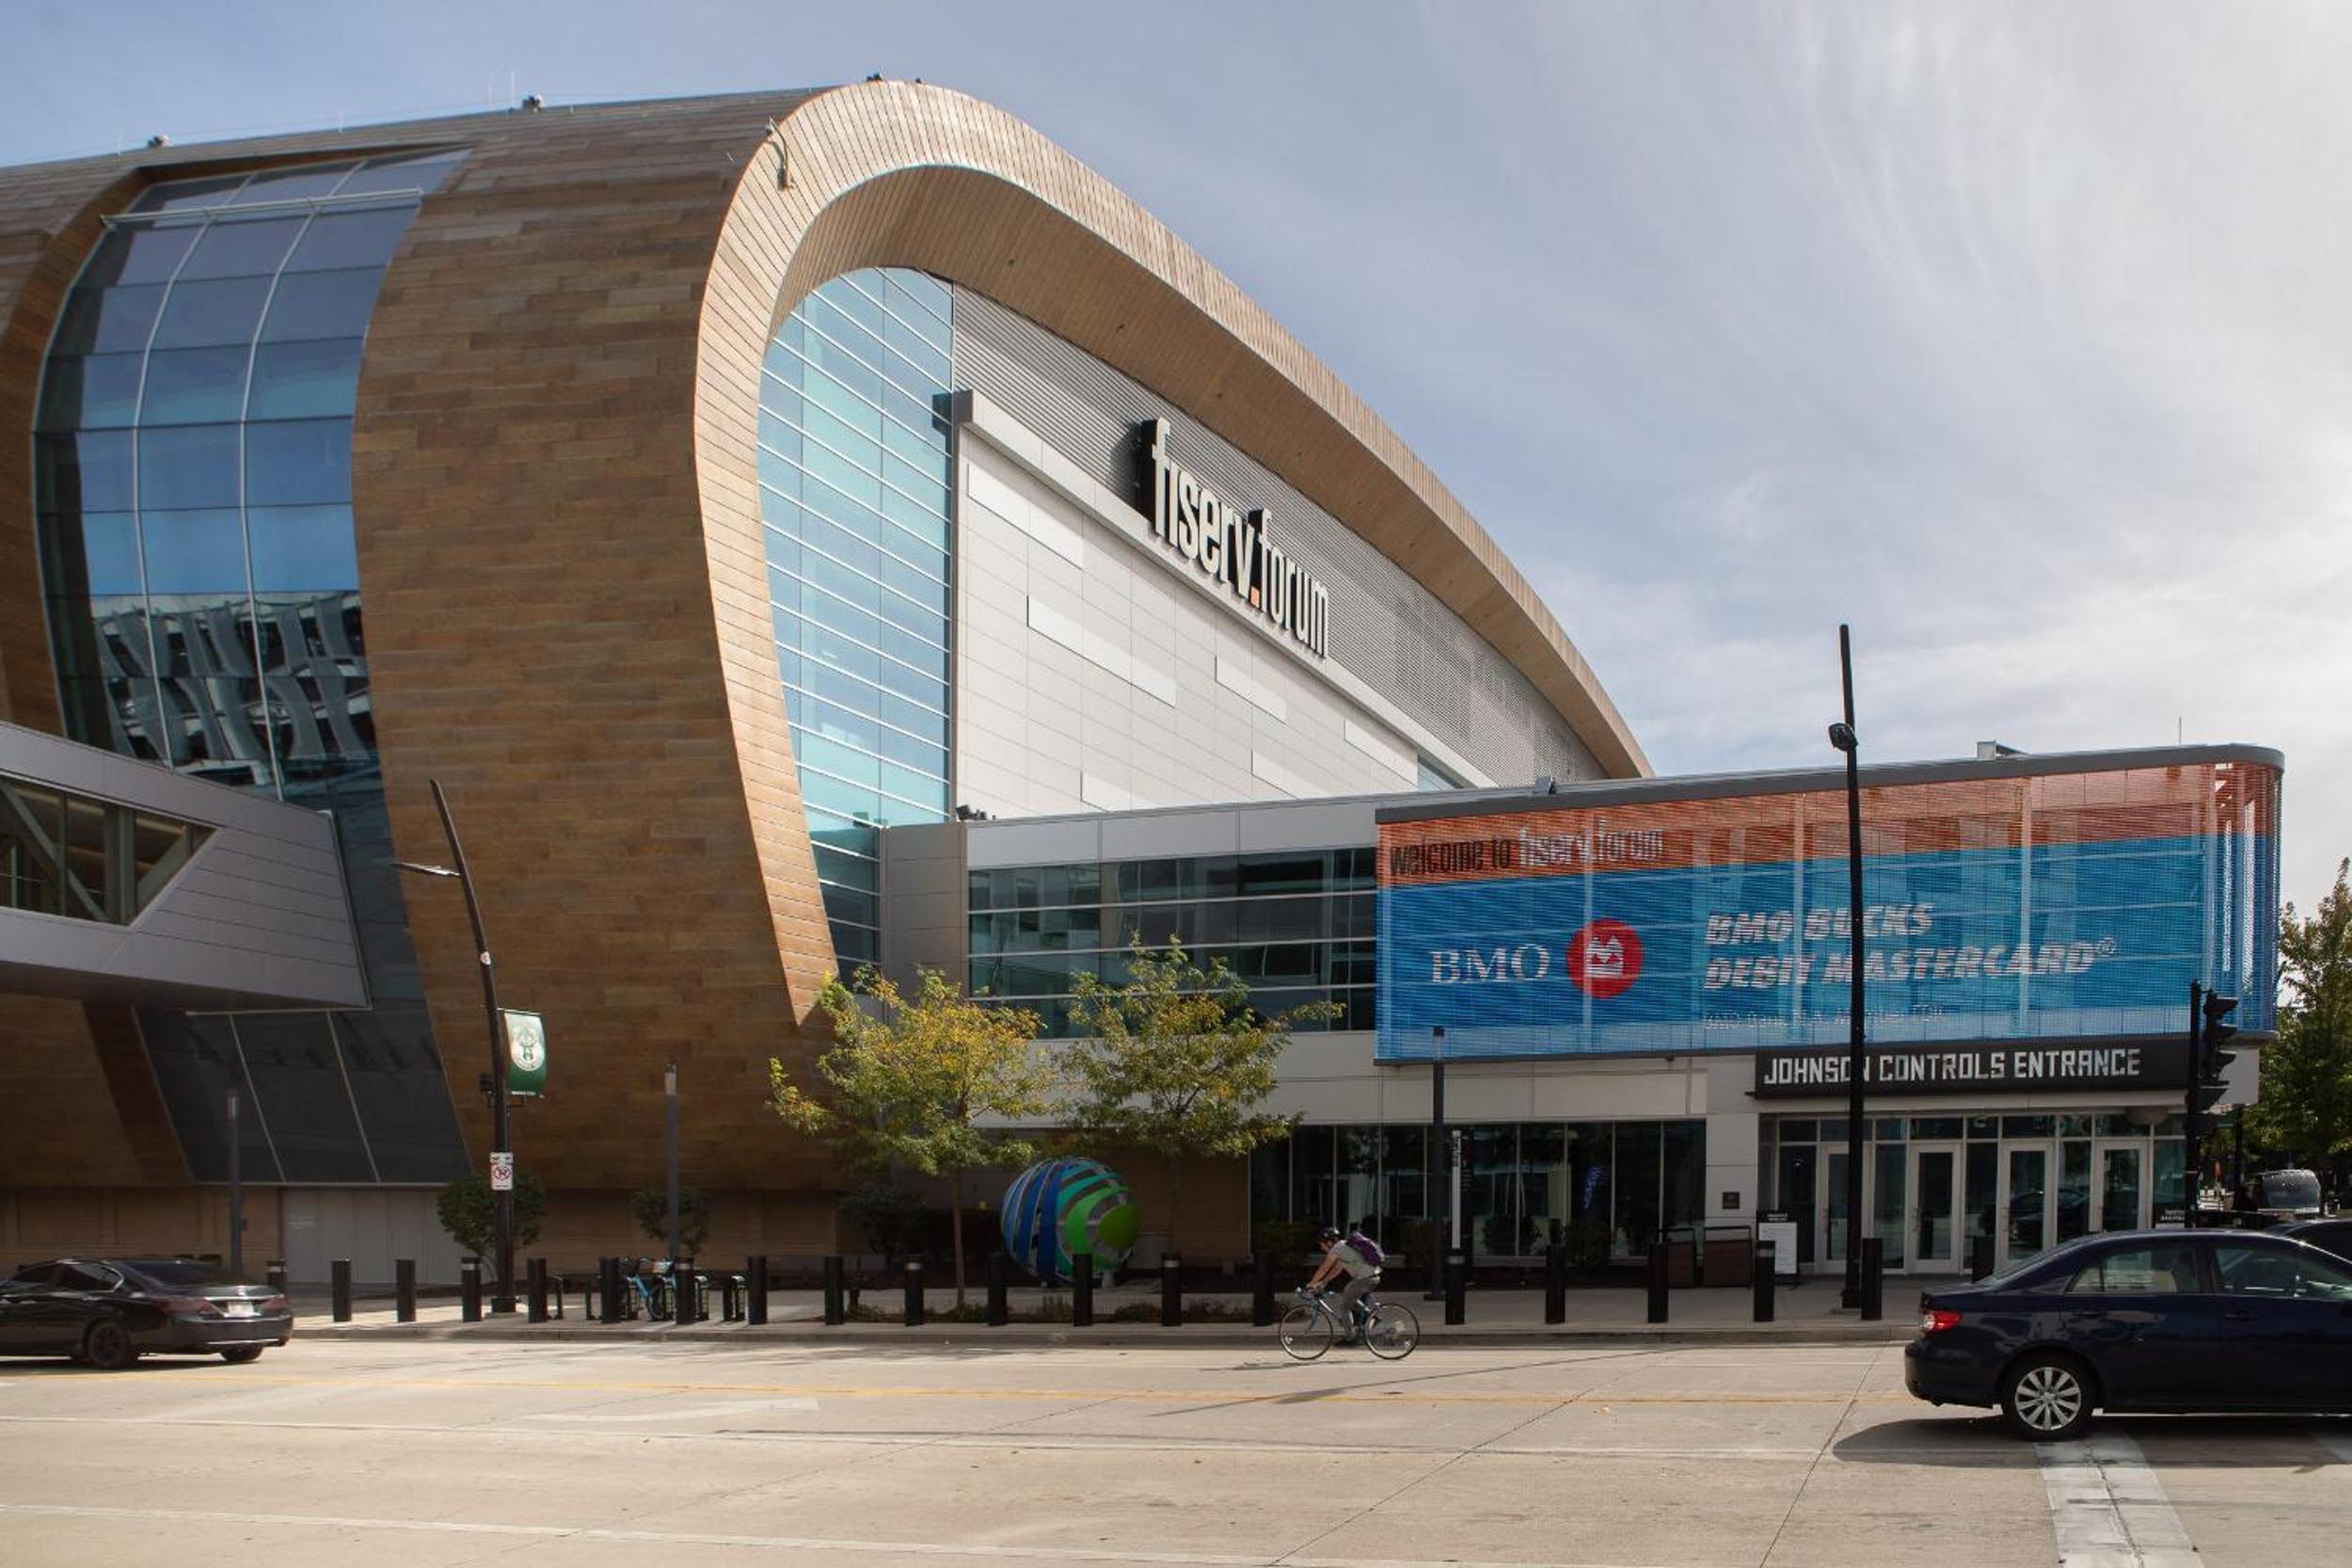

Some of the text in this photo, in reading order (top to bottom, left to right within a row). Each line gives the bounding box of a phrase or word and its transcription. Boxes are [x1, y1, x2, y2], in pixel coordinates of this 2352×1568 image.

[1391, 834, 1485, 876] welcome
[1492, 832, 1510, 869] to
[1705, 903, 1936, 945] BMO BUCKS
[1429, 943, 1550, 985] BMO
[1704, 954, 1818, 990] DEBIT
[1879, 1052, 2006, 1082] CONTROLS
[2013, 1048, 2140, 1079] ENTRANCE
